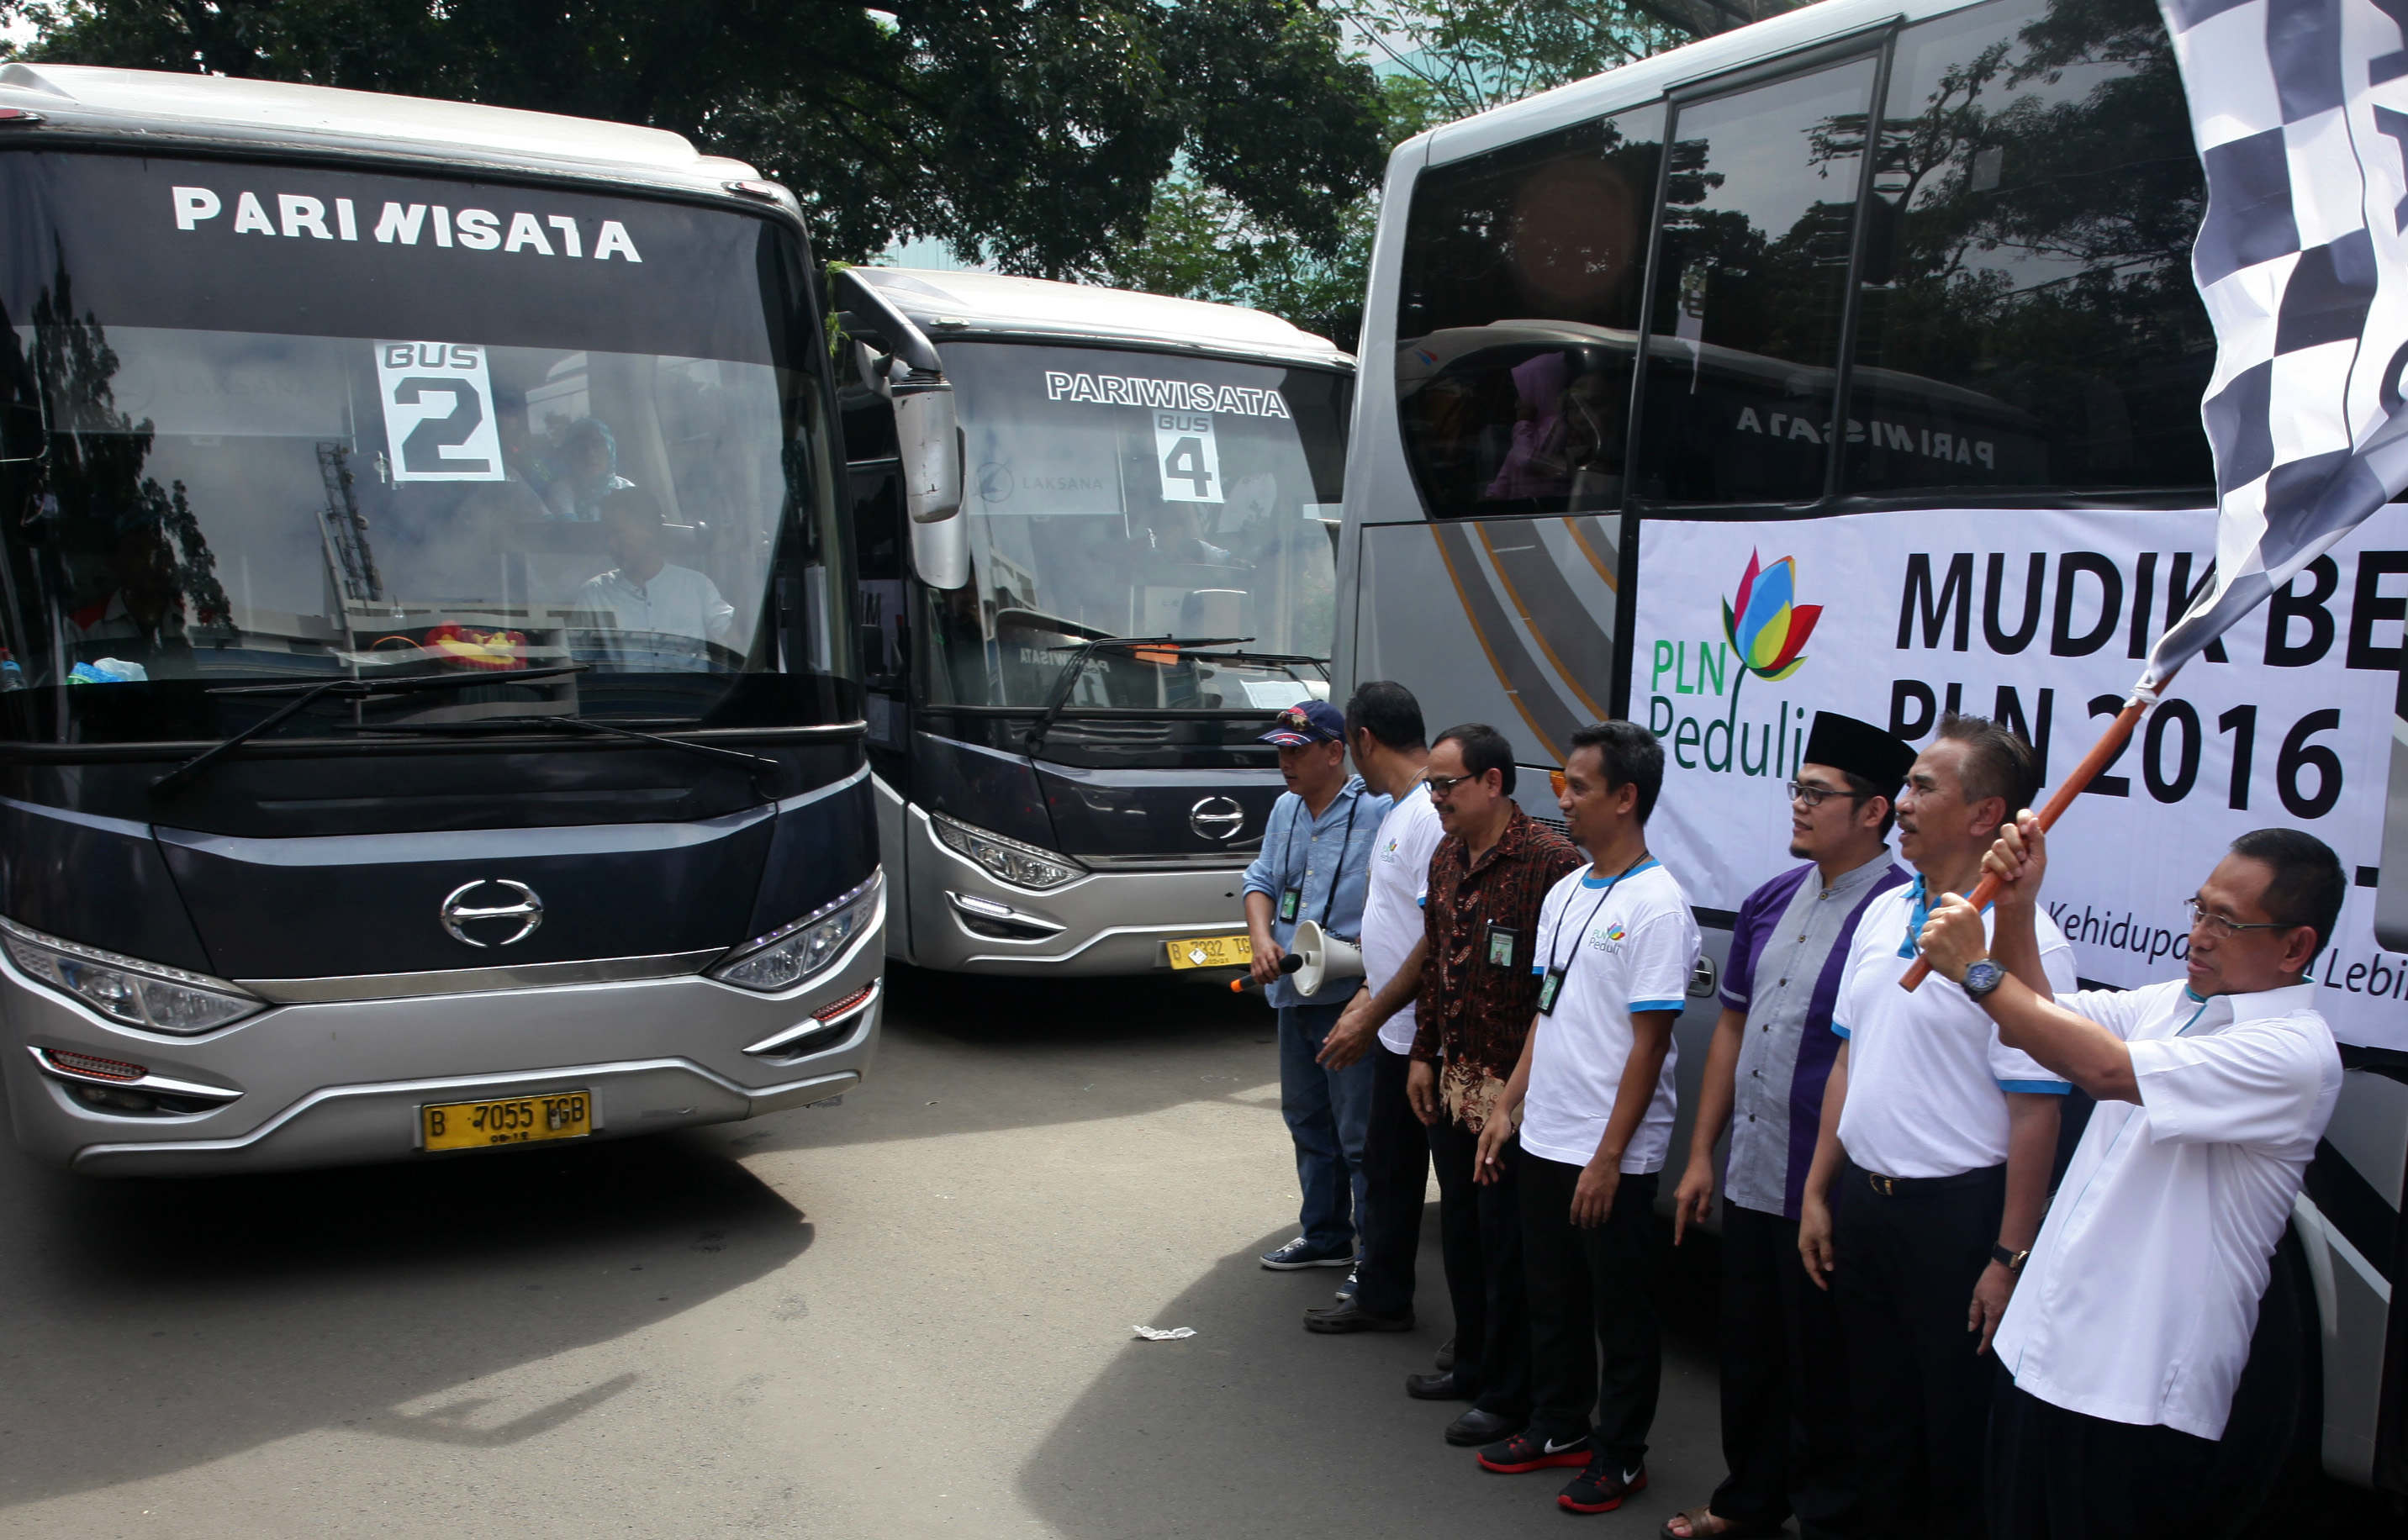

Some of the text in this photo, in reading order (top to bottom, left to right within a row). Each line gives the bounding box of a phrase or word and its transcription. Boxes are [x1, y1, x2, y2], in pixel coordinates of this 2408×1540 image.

[384, 344, 478, 370] BUS
[1045, 371, 1291, 419] PARIWISATA
[394, 377, 491, 472] 2
[1158, 414, 1209, 433] BUS
[1022, 477, 1103, 491] LAKSANA
[1164, 436, 1212, 498] 4
[1896, 551, 2408, 672] MUDIK BE
[1652, 640, 1727, 696] PLN
[1650, 696, 1804, 781] Peduli
[2080, 694, 2343, 820] 2016
[1171, 943, 1181, 961] B
[1233, 937, 1251, 954] TG
[1587, 936, 1621, 955] Peduli
[2049, 901, 2190, 965] Kehidupa
[2324, 948, 2408, 1000] Lebi
[430, 1095, 585, 1137] B 7055 TGB
